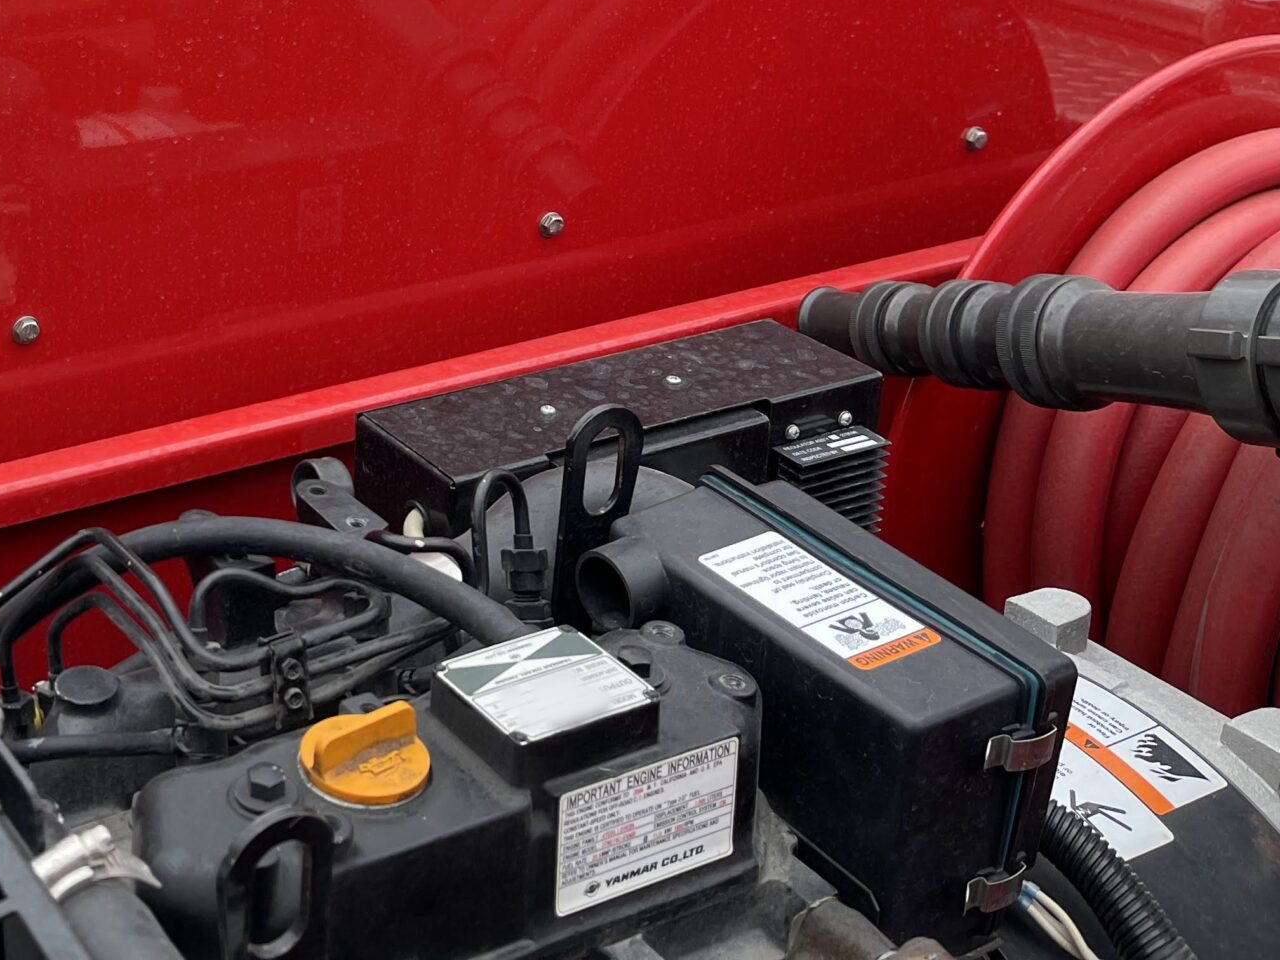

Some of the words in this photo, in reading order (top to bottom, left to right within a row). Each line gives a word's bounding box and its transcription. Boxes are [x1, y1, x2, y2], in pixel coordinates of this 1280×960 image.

[752, 553, 787, 568] operator's
[779, 555, 801, 566] living
[784, 549, 801, 557] See
[780, 563, 823, 582] compartment
[786, 559, 816, 572] maintain
[737, 574, 771, 589] tightness
[792, 568, 833, 586] Completely
[842, 586, 859, 594] can
[793, 600, 822, 612] severe
[838, 591, 869, 606] Carbon
[801, 601, 841, 619] monoxide
[853, 636, 920, 667] WARNING
[1086, 707, 1108, 724] cause
[1109, 715, 1130, 731] injury
[1096, 727, 1110, 739] Fire
[1107, 722, 1123, 734] Can
[566, 778, 622, 809] IMPORTANT
[627, 765, 662, 789] ENGINE
[668, 742, 730, 775] INFORMATION
[604, 861, 657, 888] YANMAR
